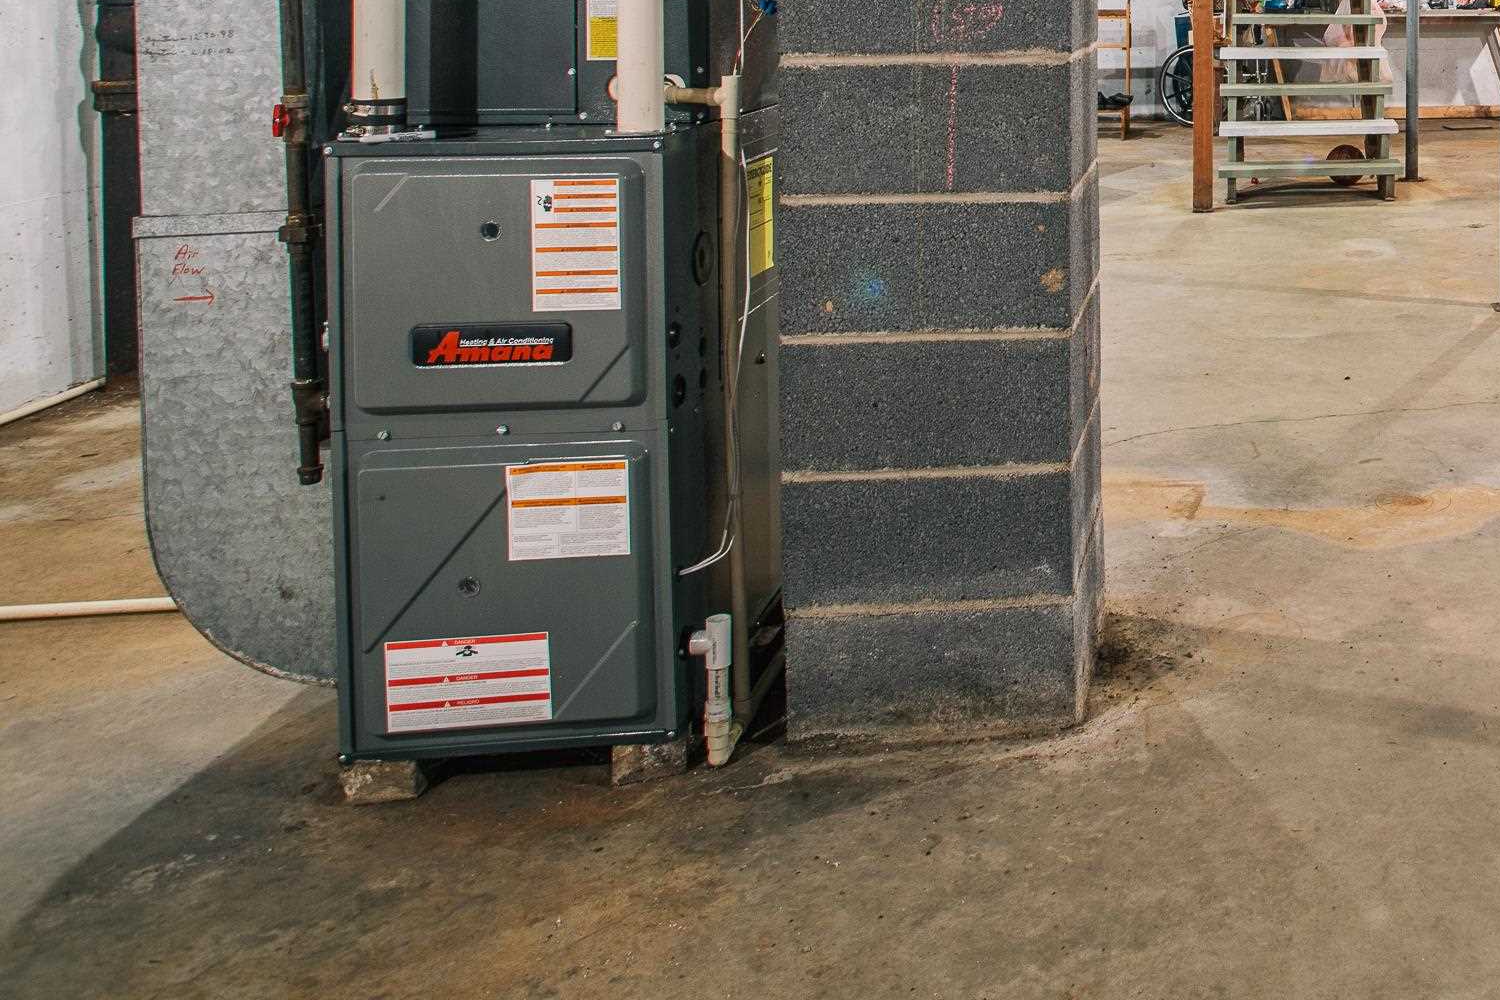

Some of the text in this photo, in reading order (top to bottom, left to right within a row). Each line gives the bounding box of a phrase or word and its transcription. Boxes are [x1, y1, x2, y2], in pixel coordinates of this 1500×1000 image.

[174, 243, 199, 260] Air
[172, 263, 205, 276] Flow
[427, 329, 554, 363] Amana
[496, 337, 508, 345] Air
[508, 336, 554, 345] Conditioning
